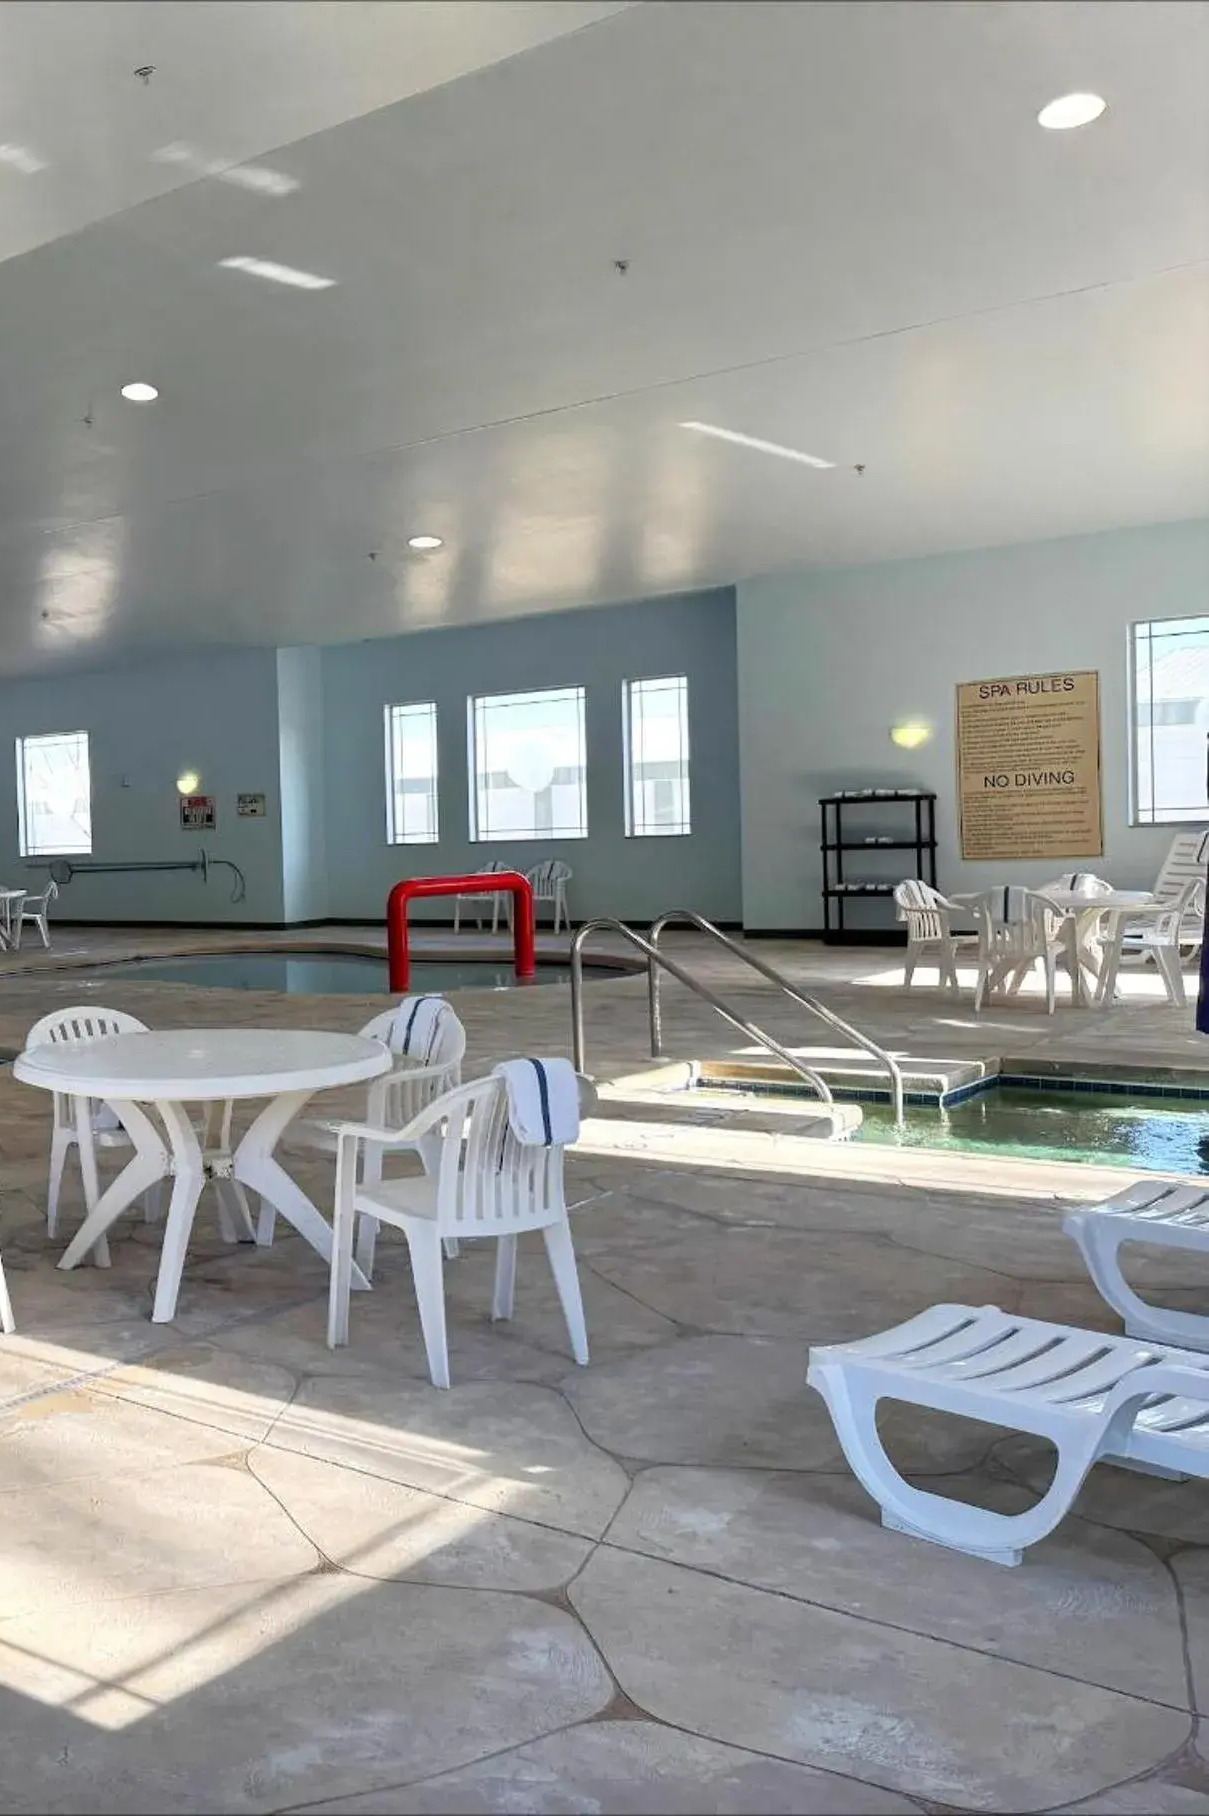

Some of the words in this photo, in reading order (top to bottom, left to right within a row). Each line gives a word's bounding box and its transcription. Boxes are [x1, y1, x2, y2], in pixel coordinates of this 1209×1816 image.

[979, 684, 1011, 699] SPA
[1016, 678, 1075, 695] RULES
[984, 774, 1009, 788] NO
[1014, 770, 1075, 786] DIVING
